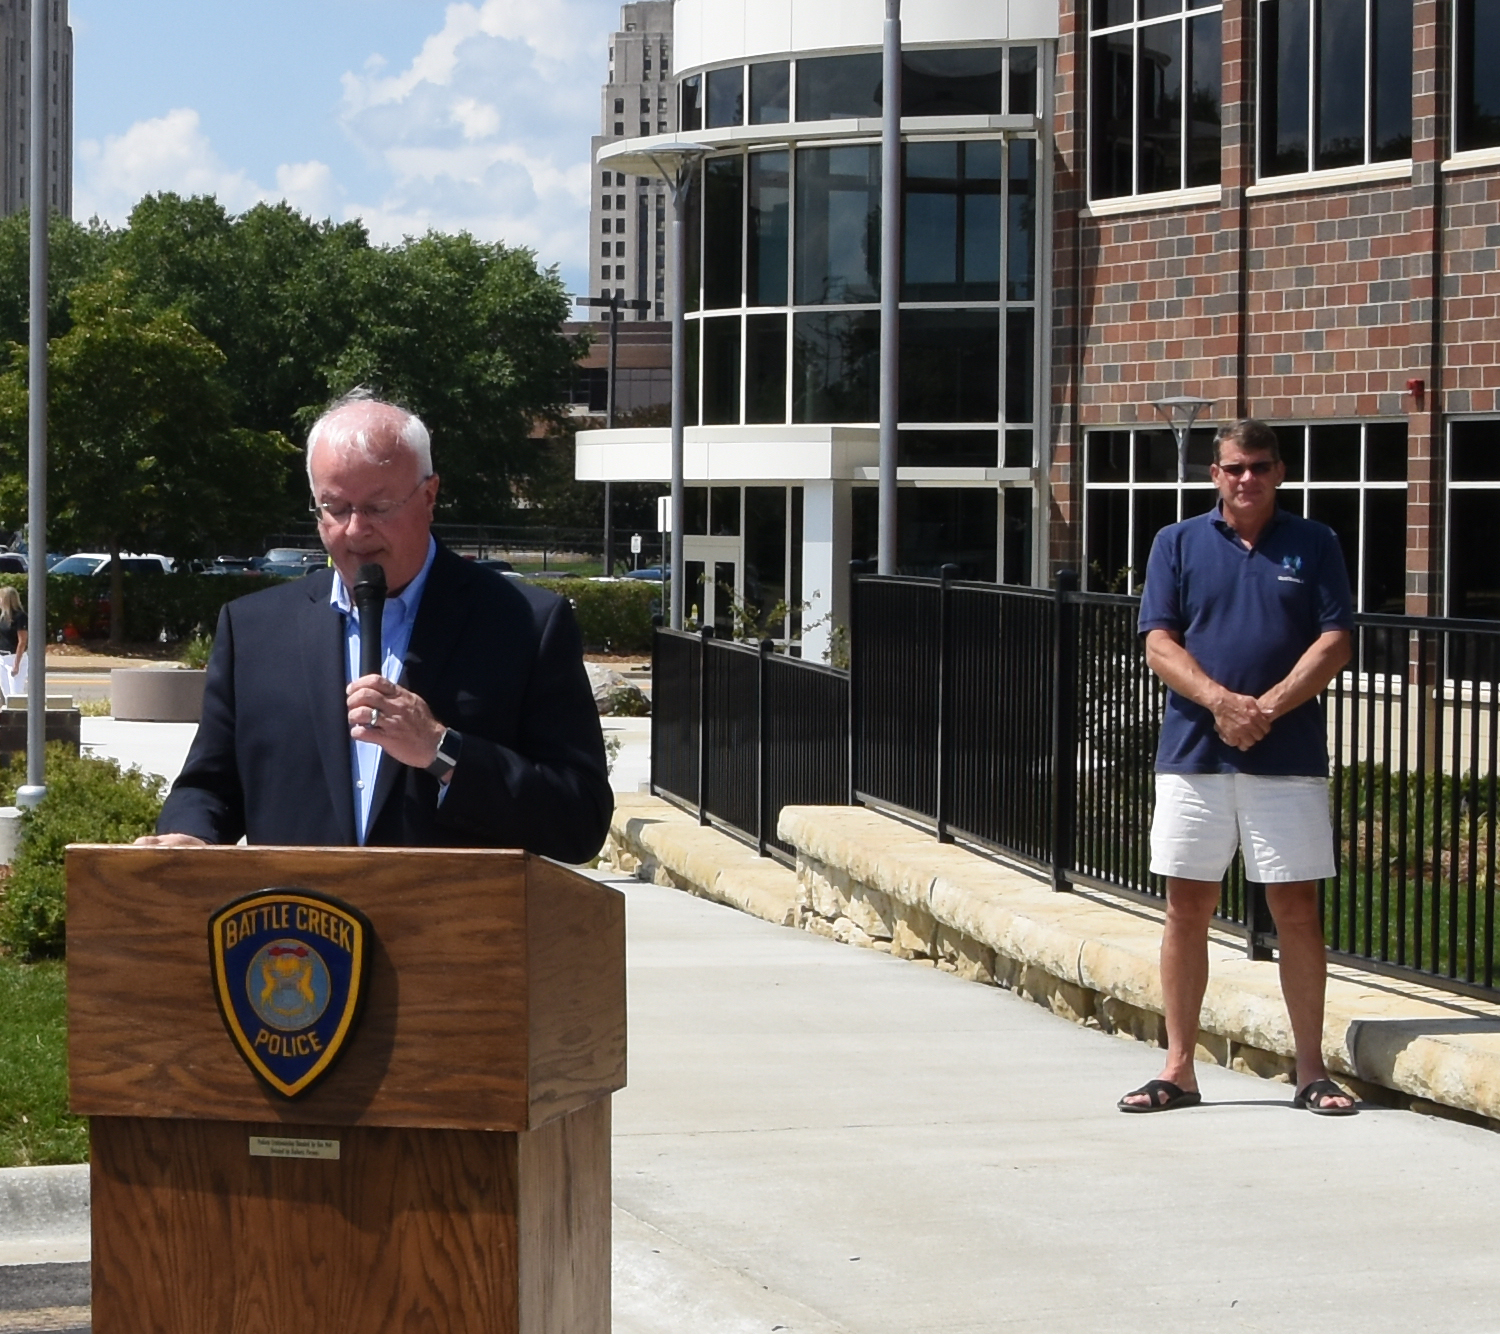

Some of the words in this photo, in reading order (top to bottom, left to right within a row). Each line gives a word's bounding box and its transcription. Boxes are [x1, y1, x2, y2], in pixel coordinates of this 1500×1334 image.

[227, 904, 290, 949] BATTLE
[296, 906, 351, 953] CREEK
[254, 1028, 323, 1057] POLICE
